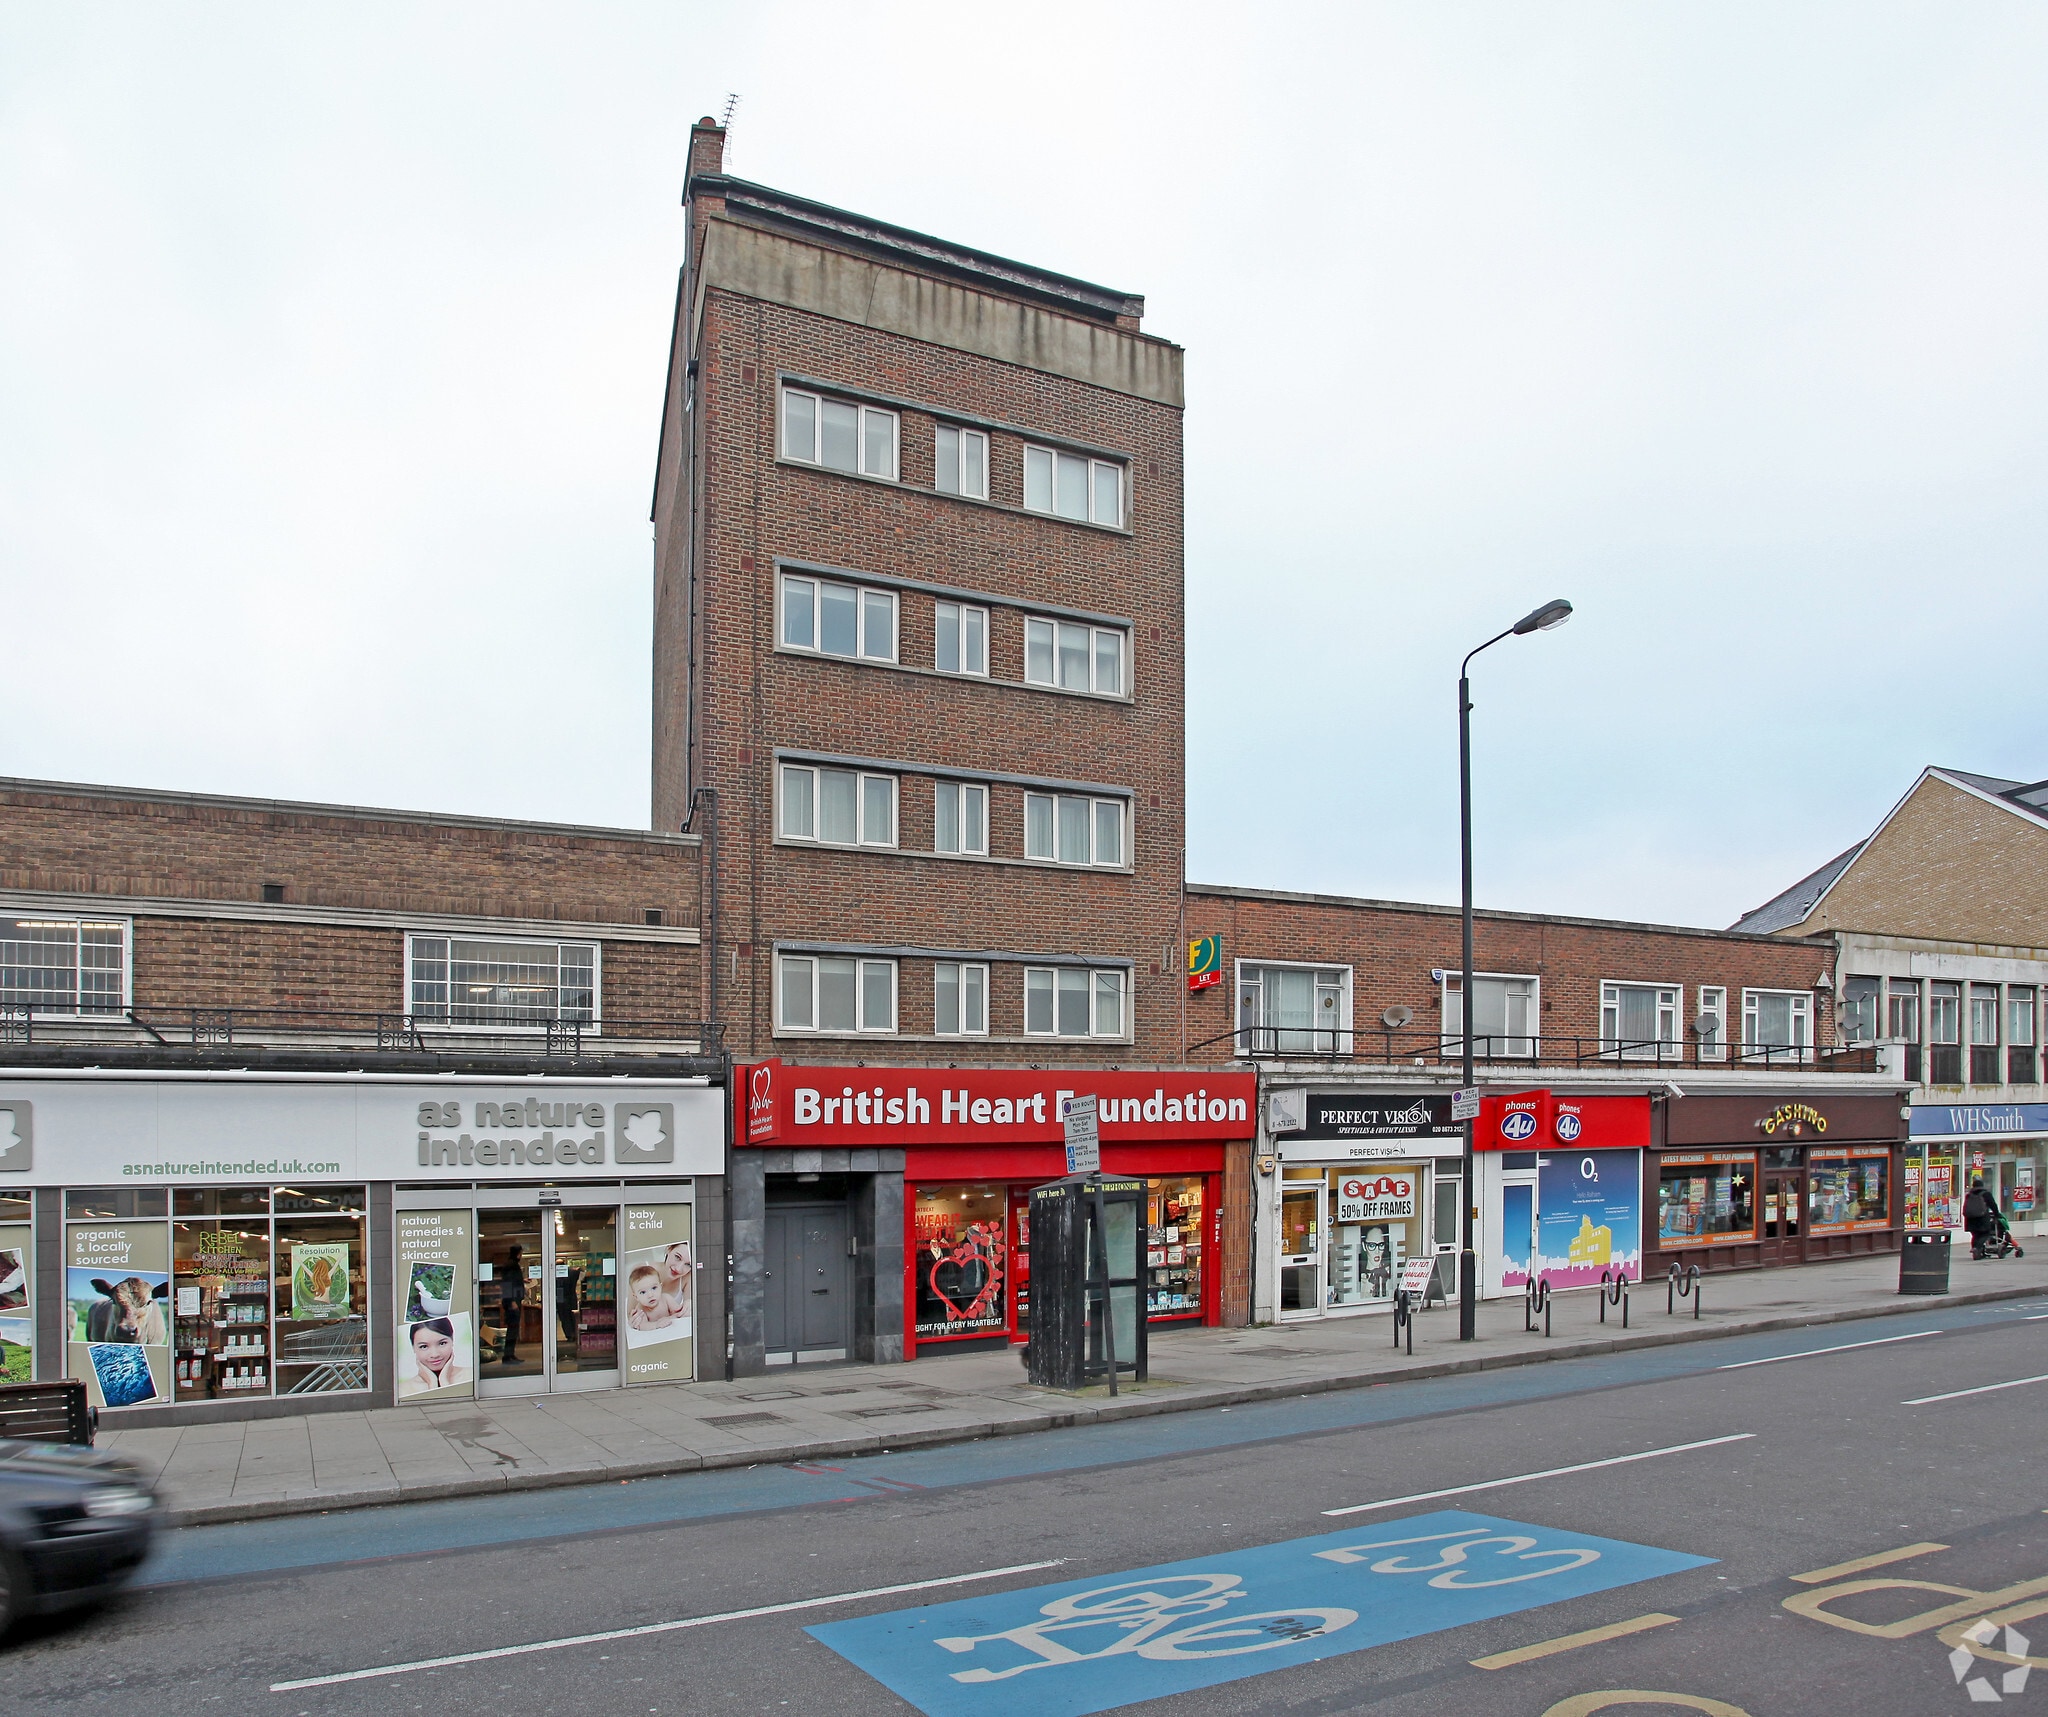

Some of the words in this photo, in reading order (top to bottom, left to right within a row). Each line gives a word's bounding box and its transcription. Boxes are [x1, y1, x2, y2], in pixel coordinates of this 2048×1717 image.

[1199, 973, 1211, 983] LET
[794, 1087, 930, 1125] British
[942, 1088, 1046, 1125] Heart
[1055, 1087, 1247, 1125] Fundation
[1072, 1101, 1080, 1109] RED
[1081, 1099, 1096, 1107] ROUTE
[1505, 1101, 1536, 1112] phones
[1558, 1102, 1581, 1113] phones
[417, 1101, 462, 1128] as
[475, 1097, 605, 1128] nature
[1320, 1110, 1379, 1125] PERFECT
[750, 1116, 761, 1127] British
[761, 1115, 773, 1124] Heart
[1949, 1107, 2025, 1132] WHSmith
[750, 1124, 773, 1136] Foundation
[1504, 1114, 1534, 1138] 4u
[1560, 1116, 1579, 1138] 4u
[418, 1131, 605, 1166] intended
[1349, 1148, 1379, 1156] PERFECT
[1680, 1154, 1705, 1162] MACHINES
[122, 1159, 341, 1176] asnatureintended.uk.com
[1905, 1168, 1919, 1180] RICE
[1049, 1189, 1060, 1197] here
[1348, 1179, 1406, 1198] SALE
[2013, 1188, 2033, 1196] 75%
[629, 1209, 656, 1221] baby
[1341, 1204, 1361, 1219] 50%
[1363, 1202, 1378, 1217] OFF
[1379, 1200, 1412, 1216] FRAMES
[401, 1215, 441, 1226] natural
[629, 1220, 637, 1230] &
[639, 1219, 663, 1230] child
[916, 1213, 949, 1228] WEAR
[951, 1212, 962, 1226] IT
[75, 1228, 126, 1242] organic
[401, 1226, 454, 1237] remedies
[456, 1226, 464, 1236] &
[76, 1242, 85, 1253] &
[88, 1241, 132, 1253] locally
[401, 1238, 441, 1249] natural
[1660, 1237, 1704, 1246] www.cashino.com
[199, 1246, 242, 1254] KITCHEN
[299, 1246, 341, 1255] Resolution
[401, 1250, 450, 1260] skincare
[75, 1253, 129, 1265] sourced
[1017, 1290, 1029, 1298] your
[1017, 1303, 1029, 1311] 020
[933, 1322, 946, 1331] FOR
[946, 1320, 966, 1330] EVERY
[967, 1317, 1003, 1328] HEARTBEAT
[630, 1360, 669, 1373] organic
